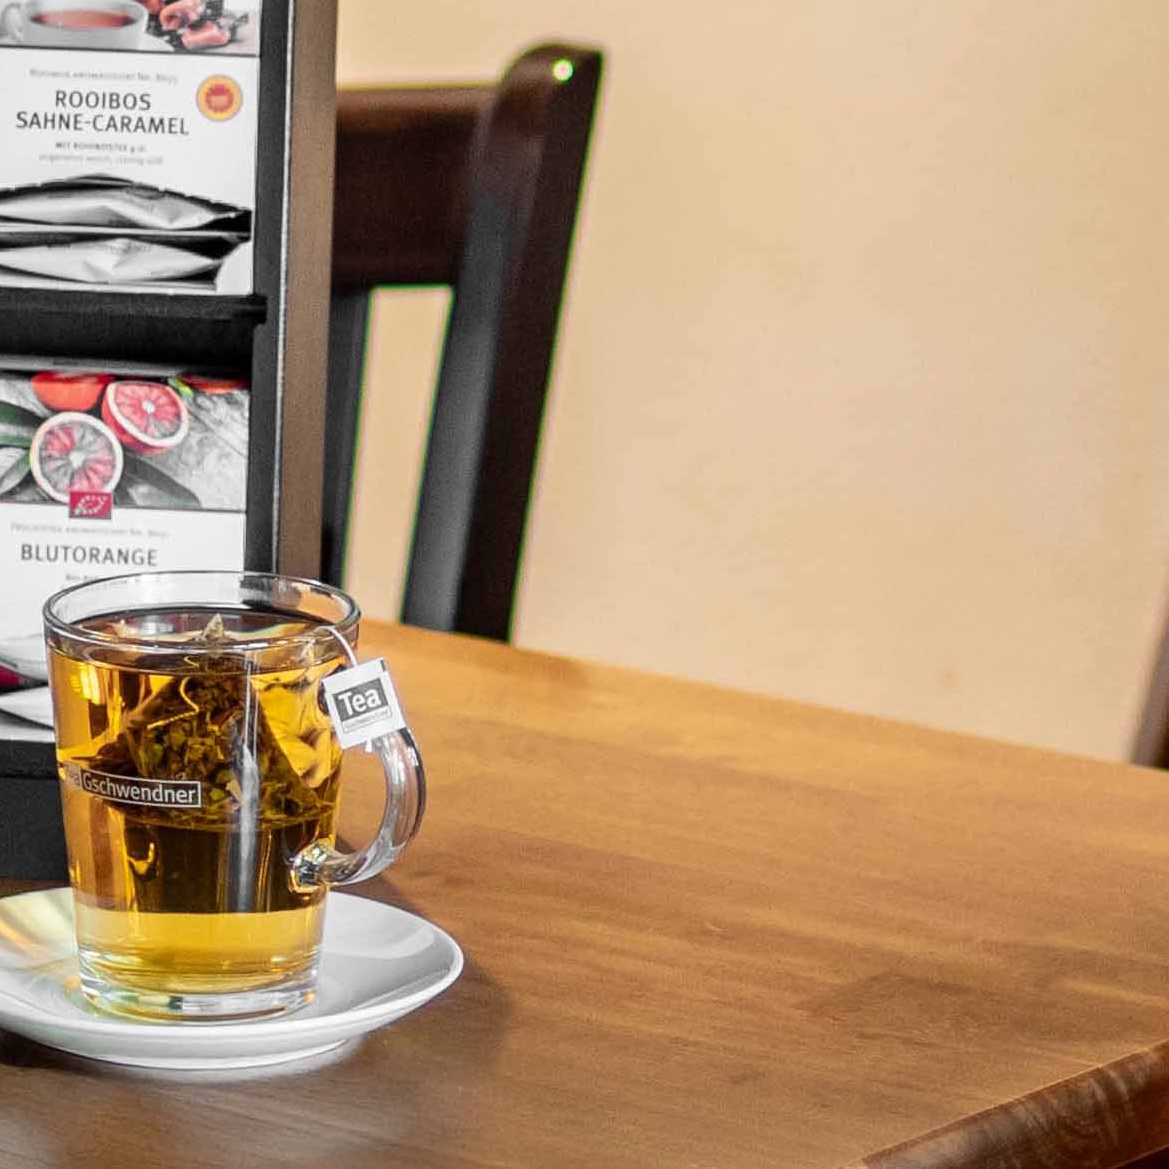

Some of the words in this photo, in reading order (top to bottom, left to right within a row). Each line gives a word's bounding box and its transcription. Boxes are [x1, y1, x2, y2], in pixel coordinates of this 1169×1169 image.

[54, 90, 151, 112] ROOIBOS
[15, 110, 190, 136] SAHNE-CARAMEL
[20, 543, 158, 567] BLUTORANGE
[337, 688, 382, 717] Tea
[82, 772, 197, 804] Gschwendner
